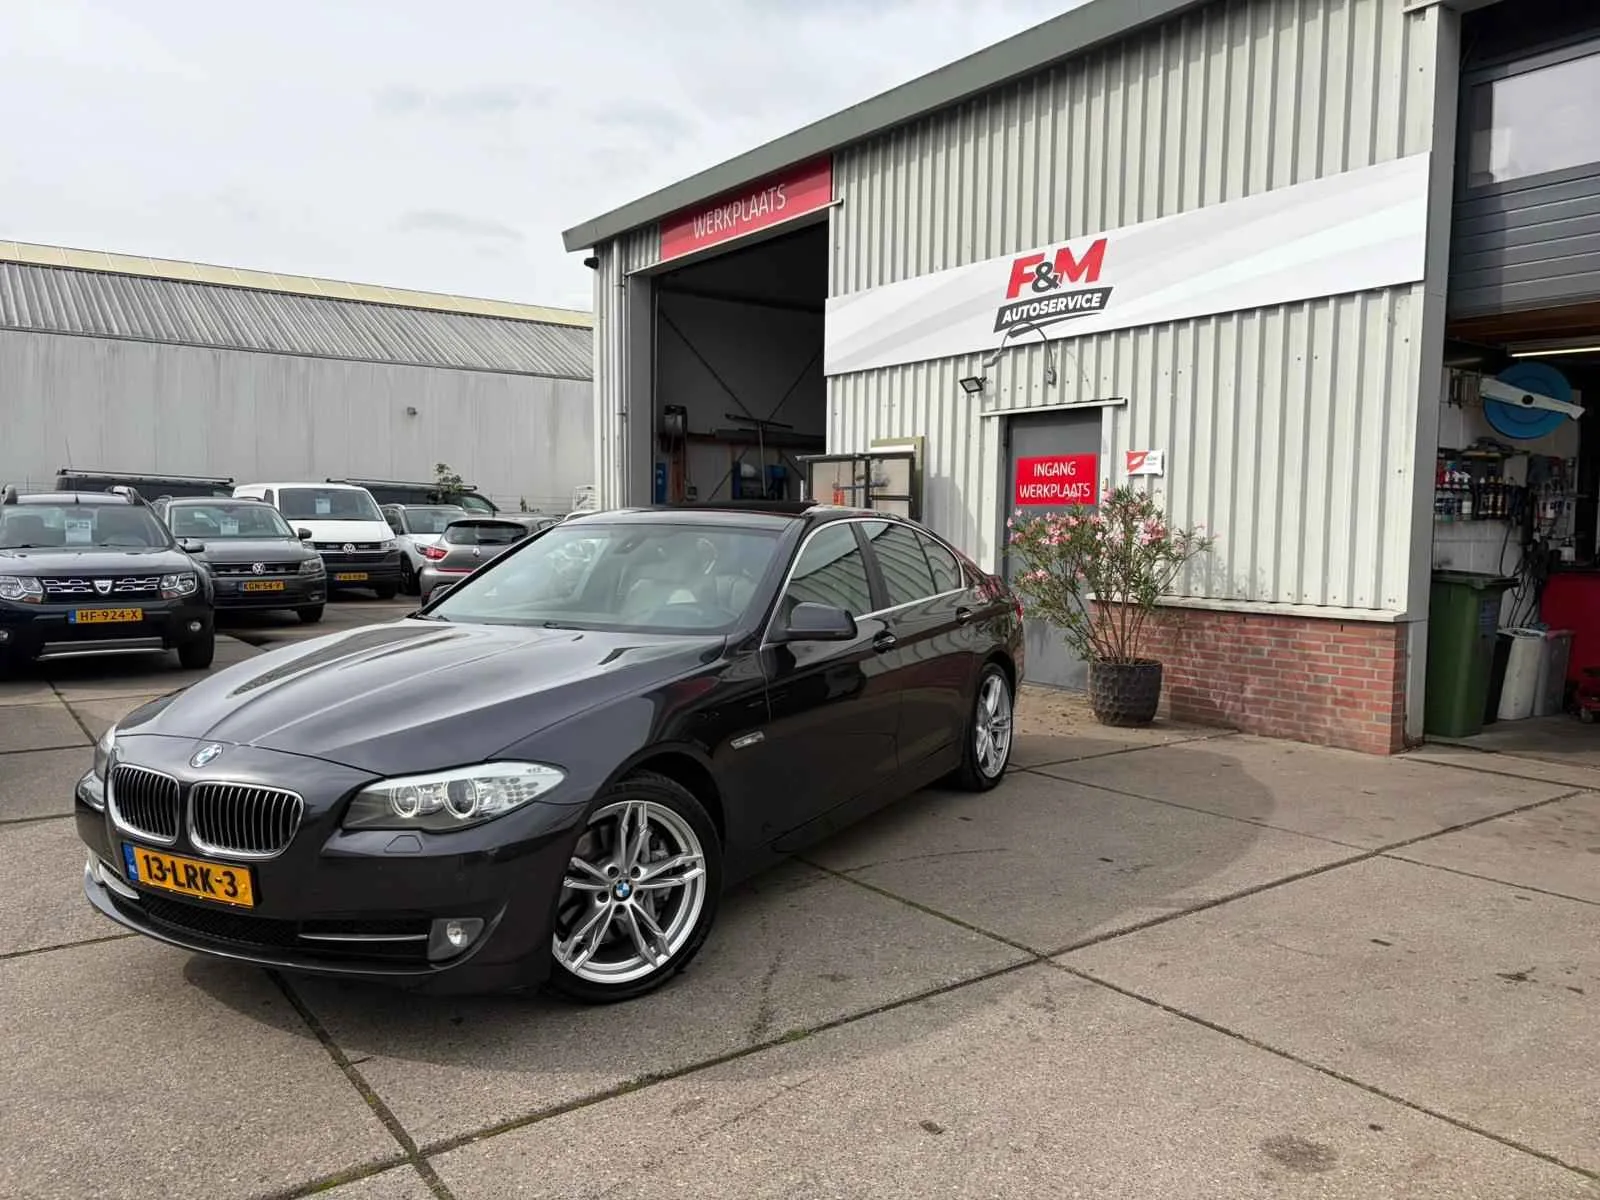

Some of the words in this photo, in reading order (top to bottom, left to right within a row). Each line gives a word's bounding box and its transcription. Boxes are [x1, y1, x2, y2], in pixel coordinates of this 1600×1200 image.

[693, 183, 787, 239] WERKPLAATS
[1005, 238, 1107, 300] F&M
[1001, 293, 1102, 325] AUTOSERVICE
[1033, 461, 1077, 477] INGANG
[1019, 482, 1090, 499] WERKPLAATS
[80, 609, 138, 622] HF-924-X
[143, 854, 239, 898] 13-LRK-3
